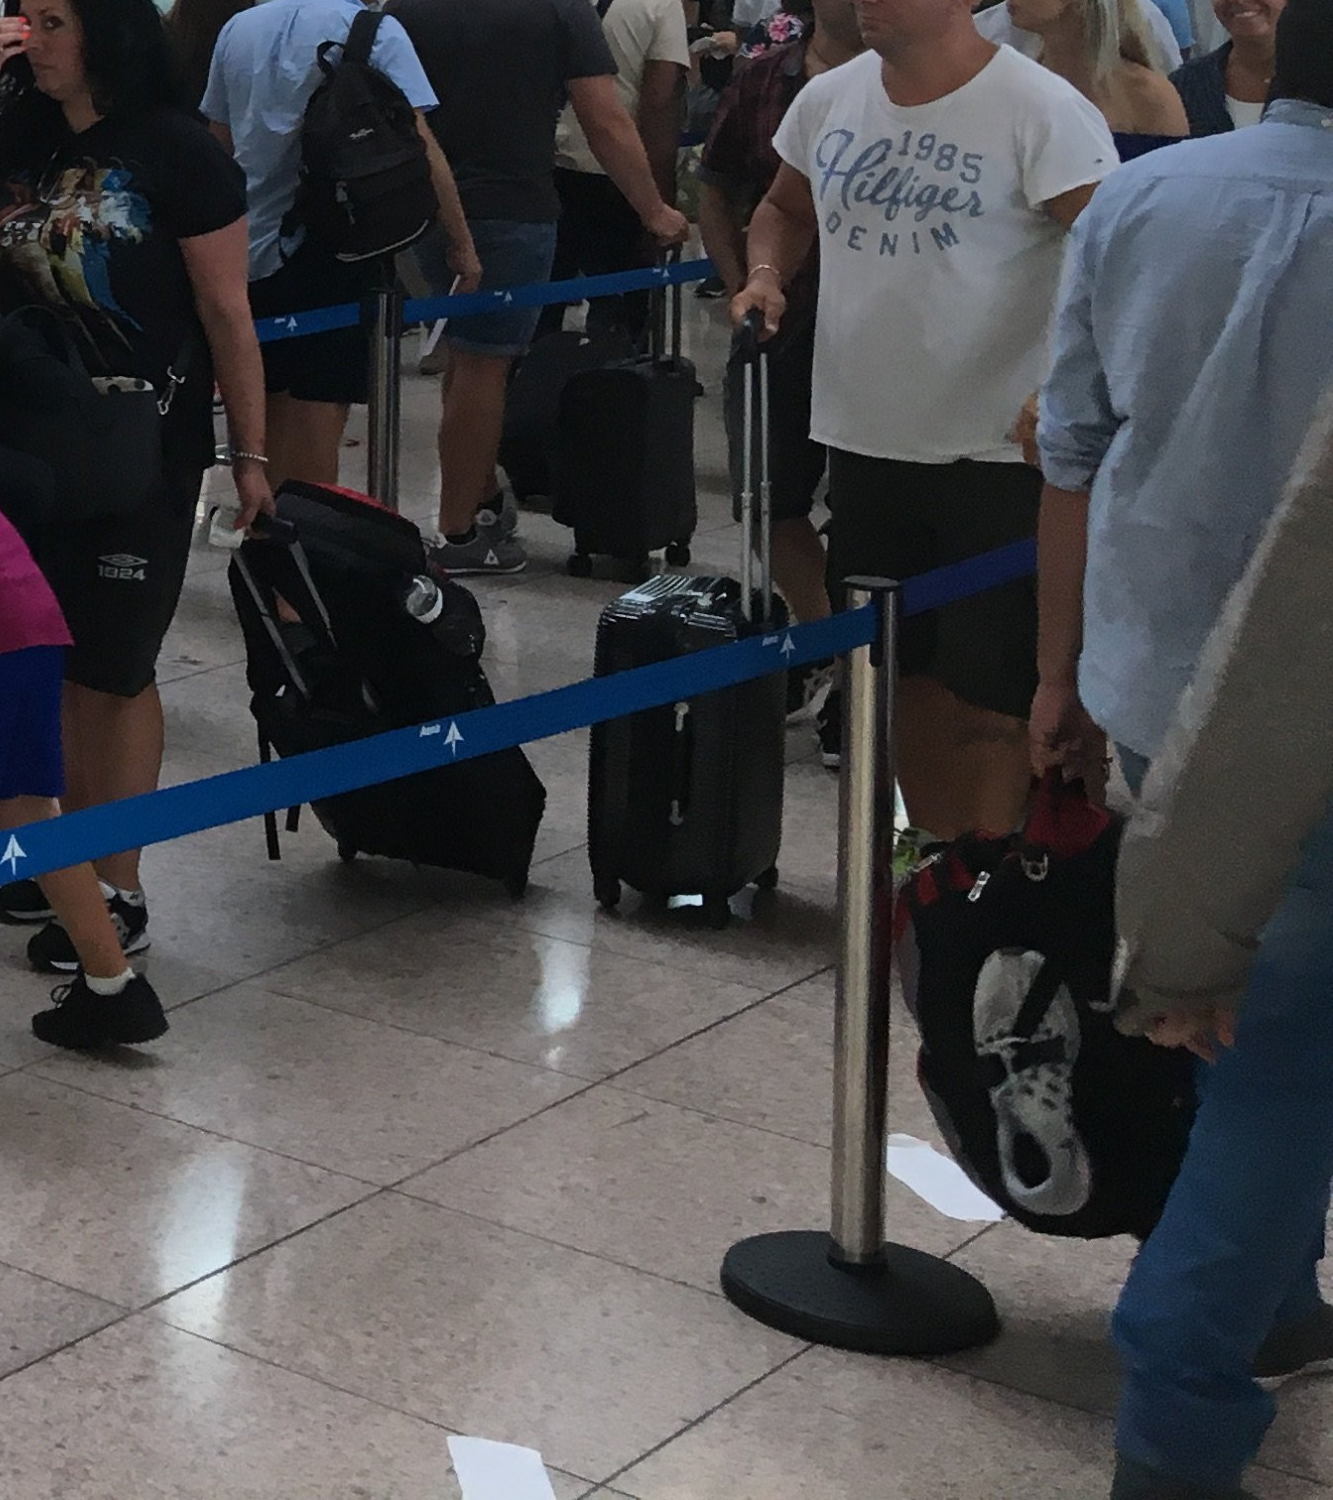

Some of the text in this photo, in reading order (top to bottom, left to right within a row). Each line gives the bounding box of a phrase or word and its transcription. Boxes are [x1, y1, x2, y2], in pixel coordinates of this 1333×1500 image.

[816, 128, 985, 222] Hilfiger
[897, 130, 984, 184] 1985
[825, 211, 960, 257] DENIM
[97, 564, 146, 581] 1924
